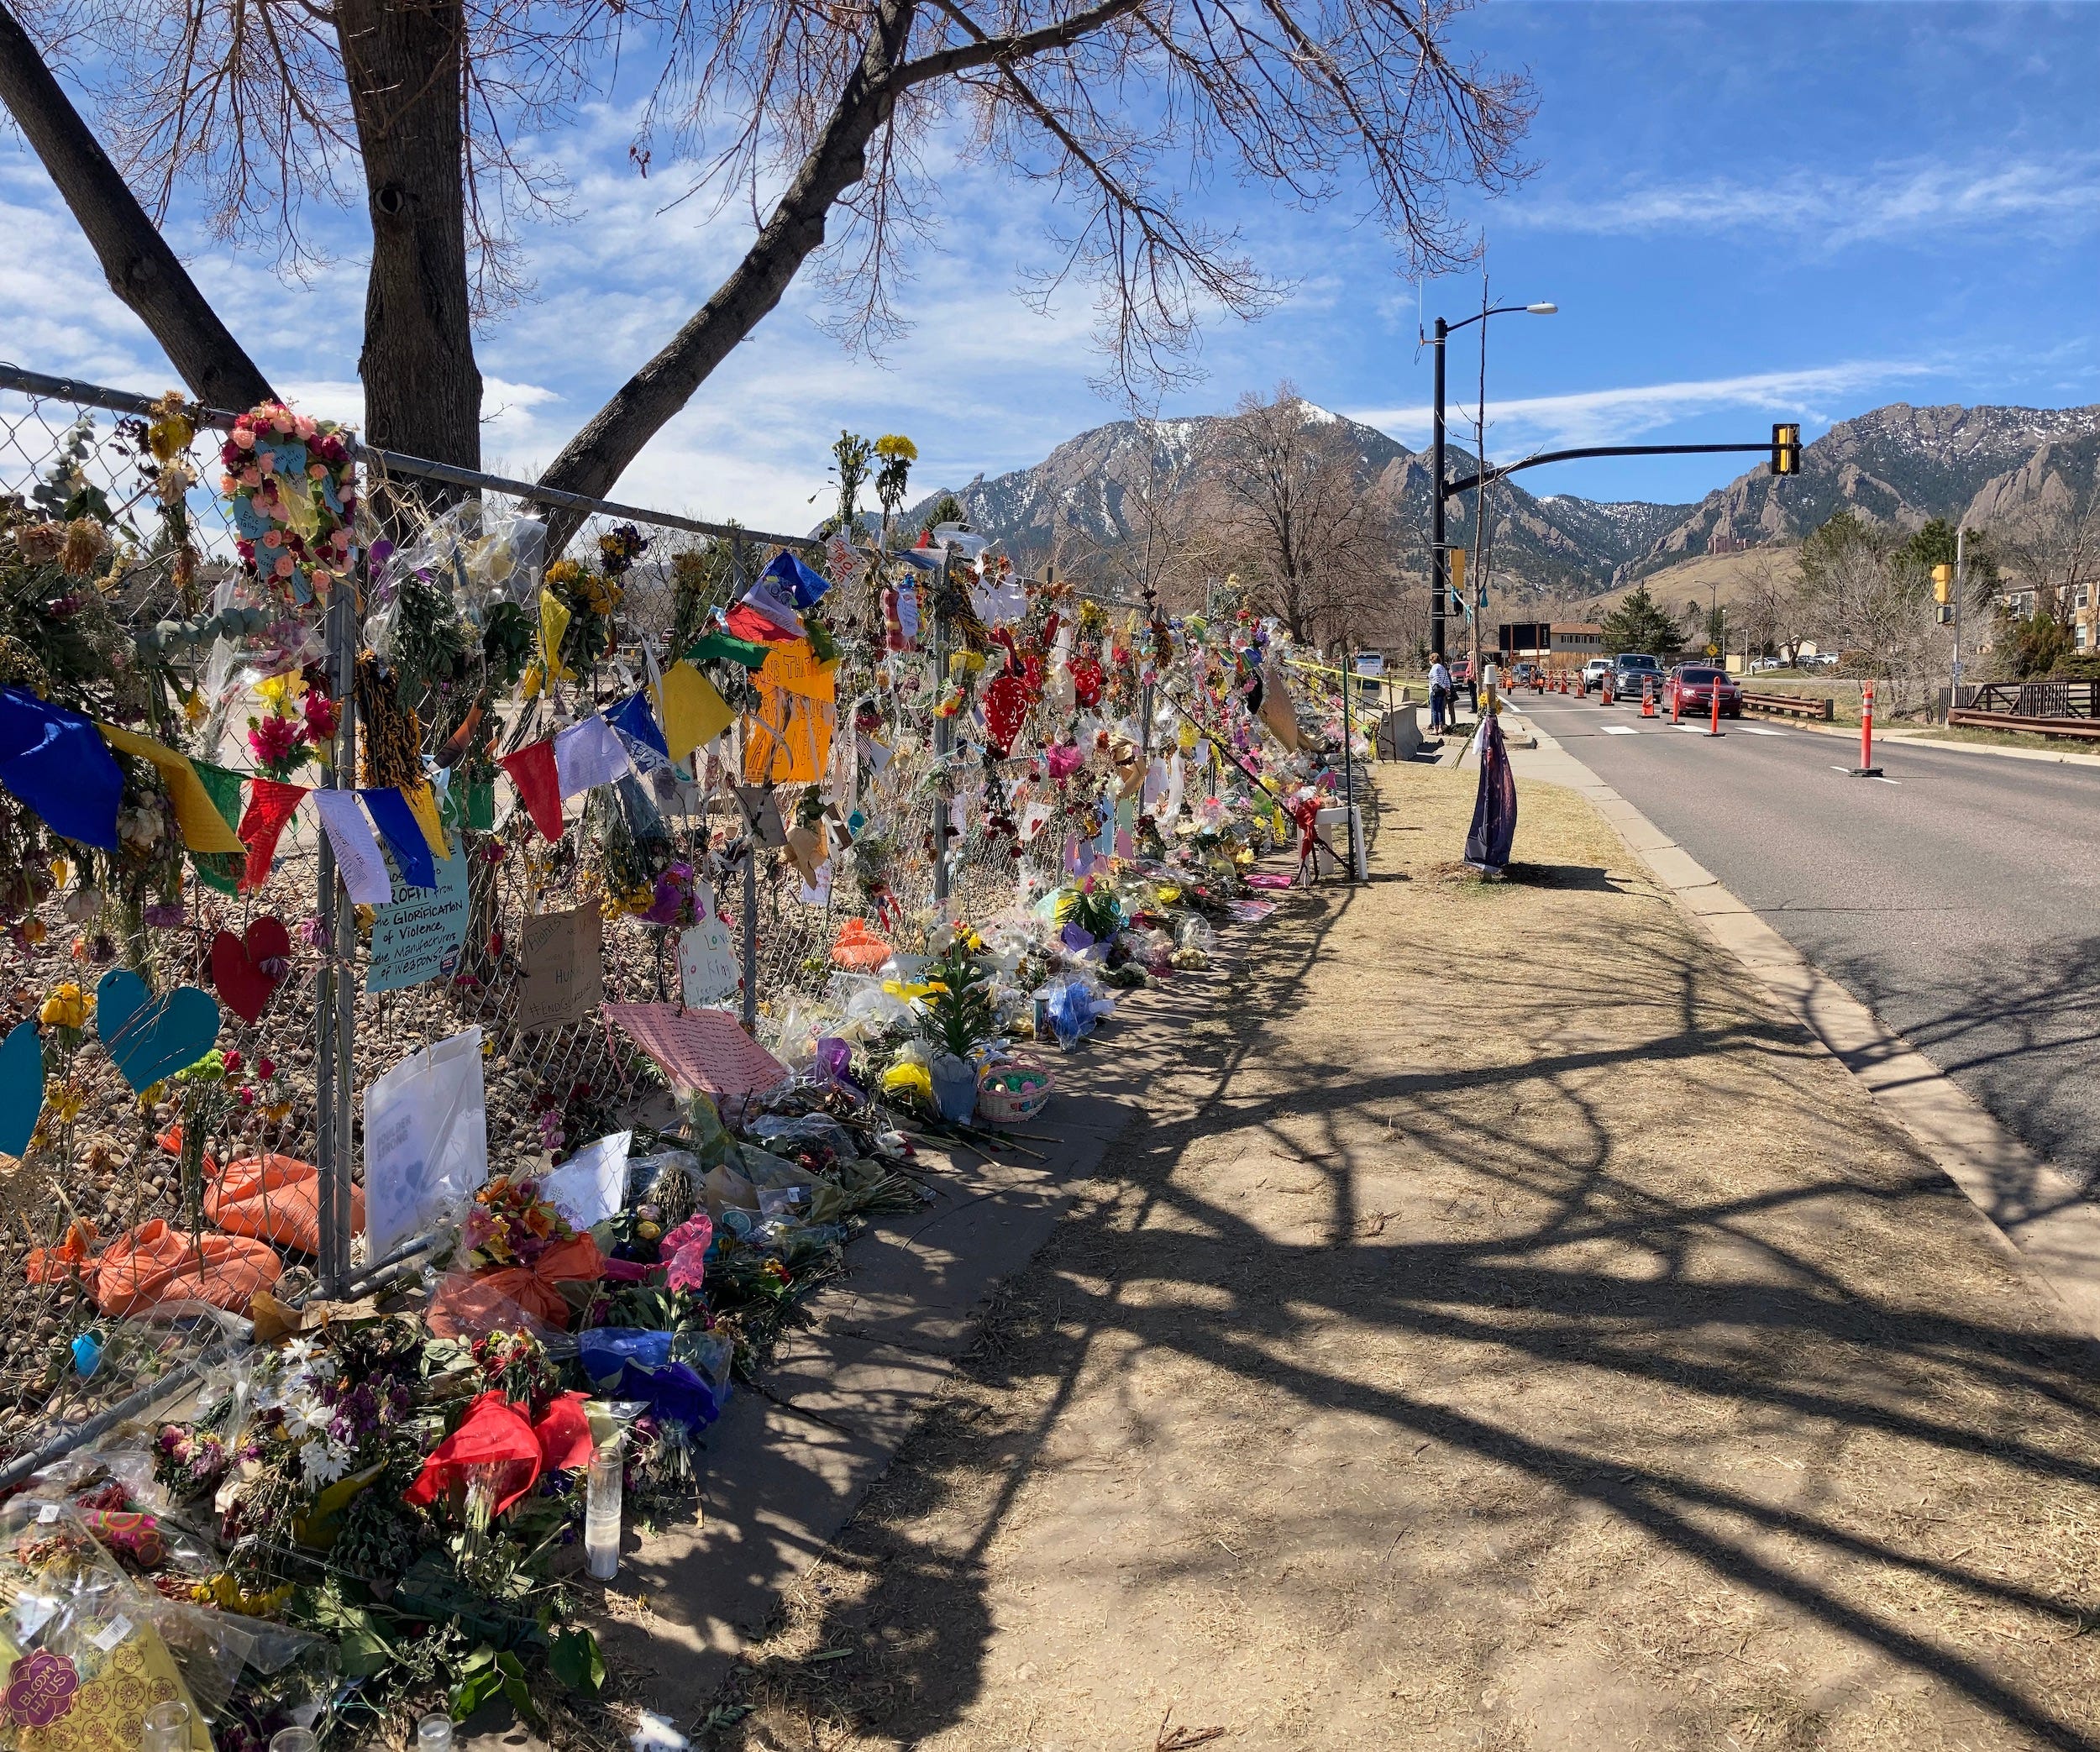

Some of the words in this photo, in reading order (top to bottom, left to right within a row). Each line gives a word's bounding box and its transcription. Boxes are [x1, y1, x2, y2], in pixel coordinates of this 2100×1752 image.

[239, 517, 259, 534] Talley
[243, 510, 259, 525] Eric
[383, 931, 395, 946] of
[527, 918, 561, 951] Rights
[381, 966, 391, 982] of
[18, 1665, 55, 1707] BLOOM
[29, 1673, 66, 1715] HAUS
